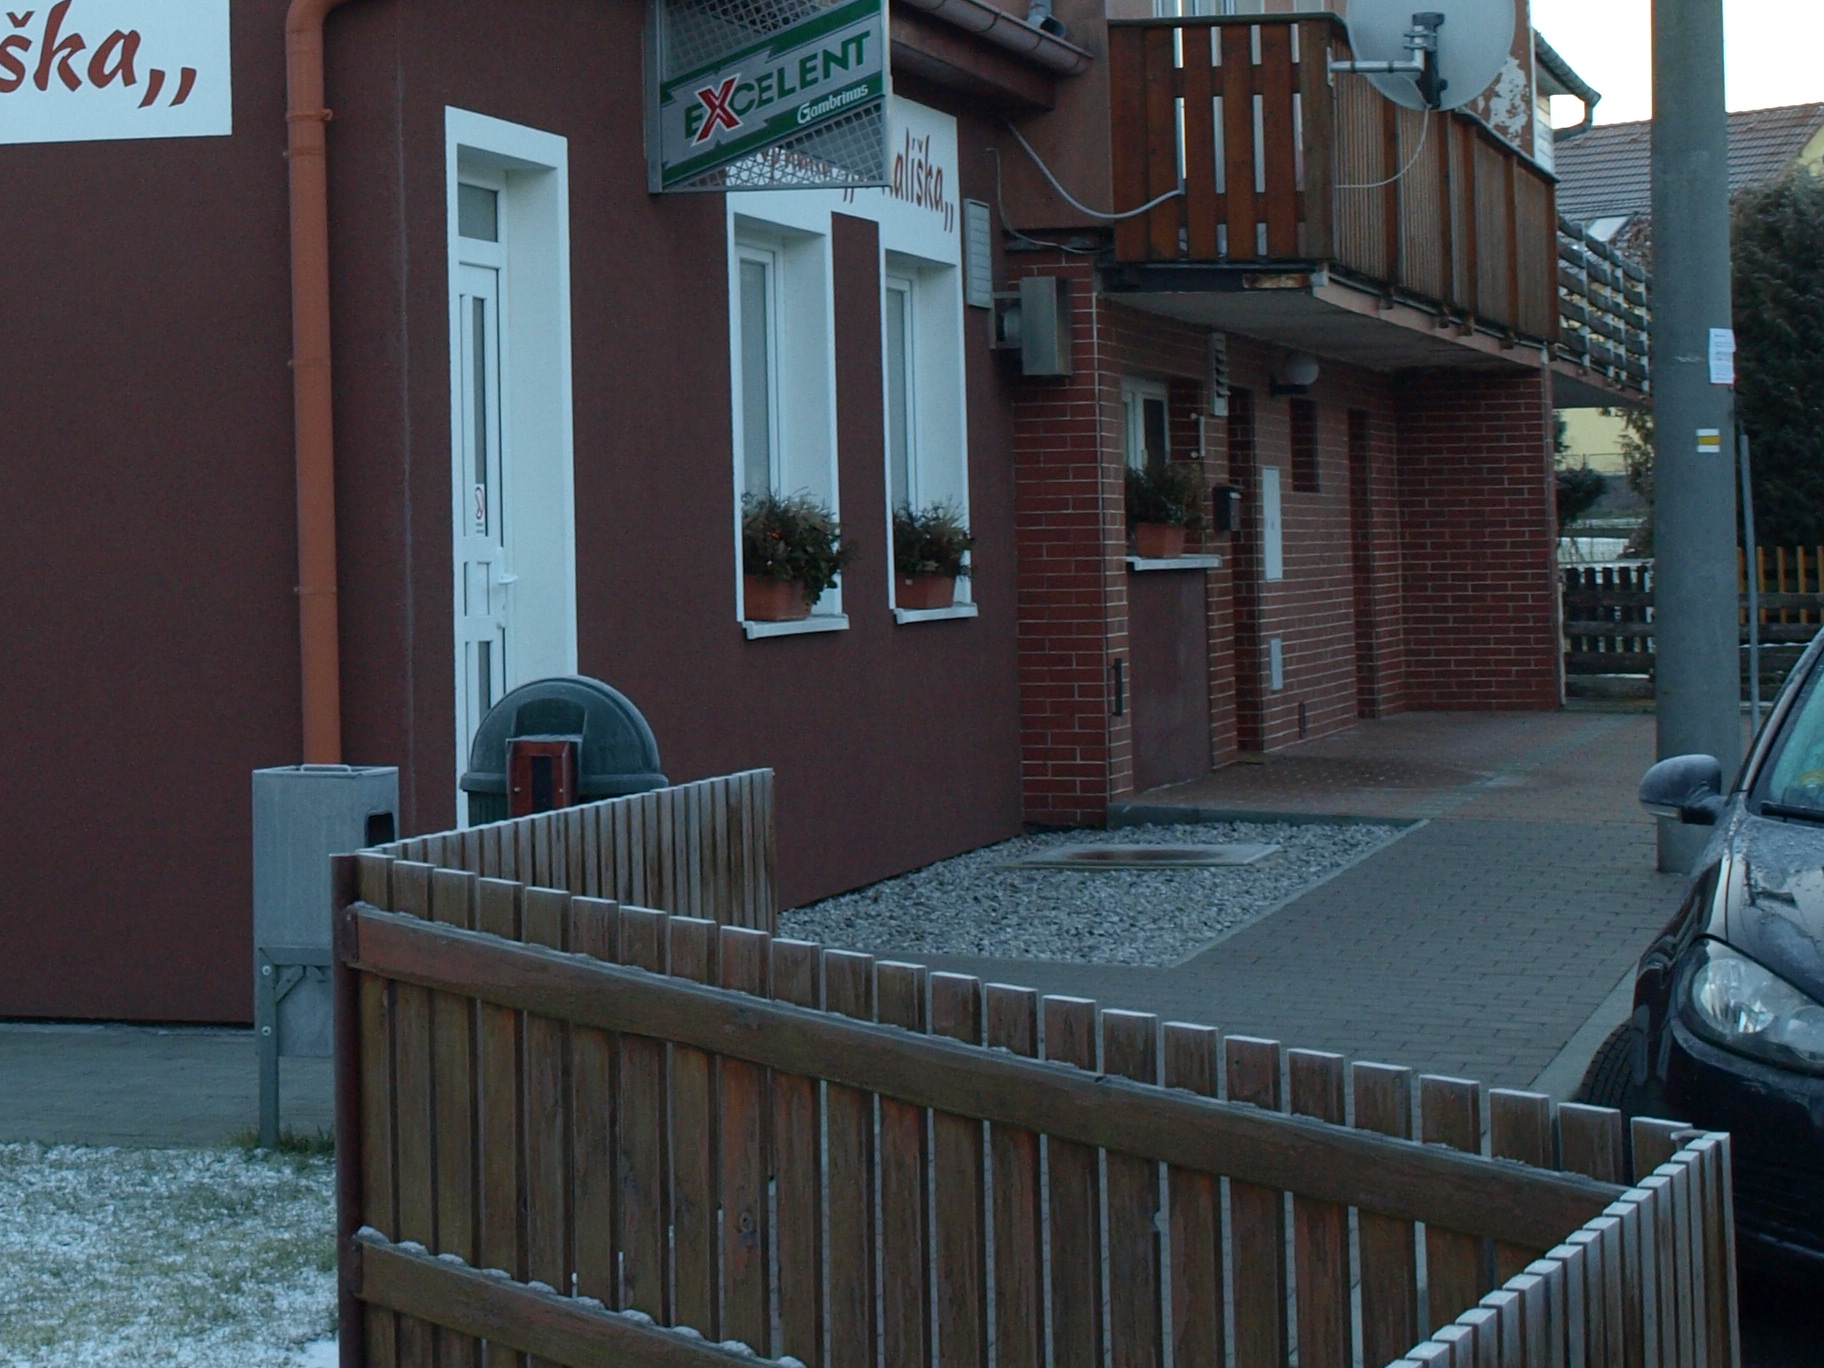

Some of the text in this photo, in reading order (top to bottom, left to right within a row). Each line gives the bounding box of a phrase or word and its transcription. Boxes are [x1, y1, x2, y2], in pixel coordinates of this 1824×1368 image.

[684, 30, 872, 146] EXCELENT
[797, 83, 869, 125] Gambrinus
[882, 126, 954, 233] alíška,,
